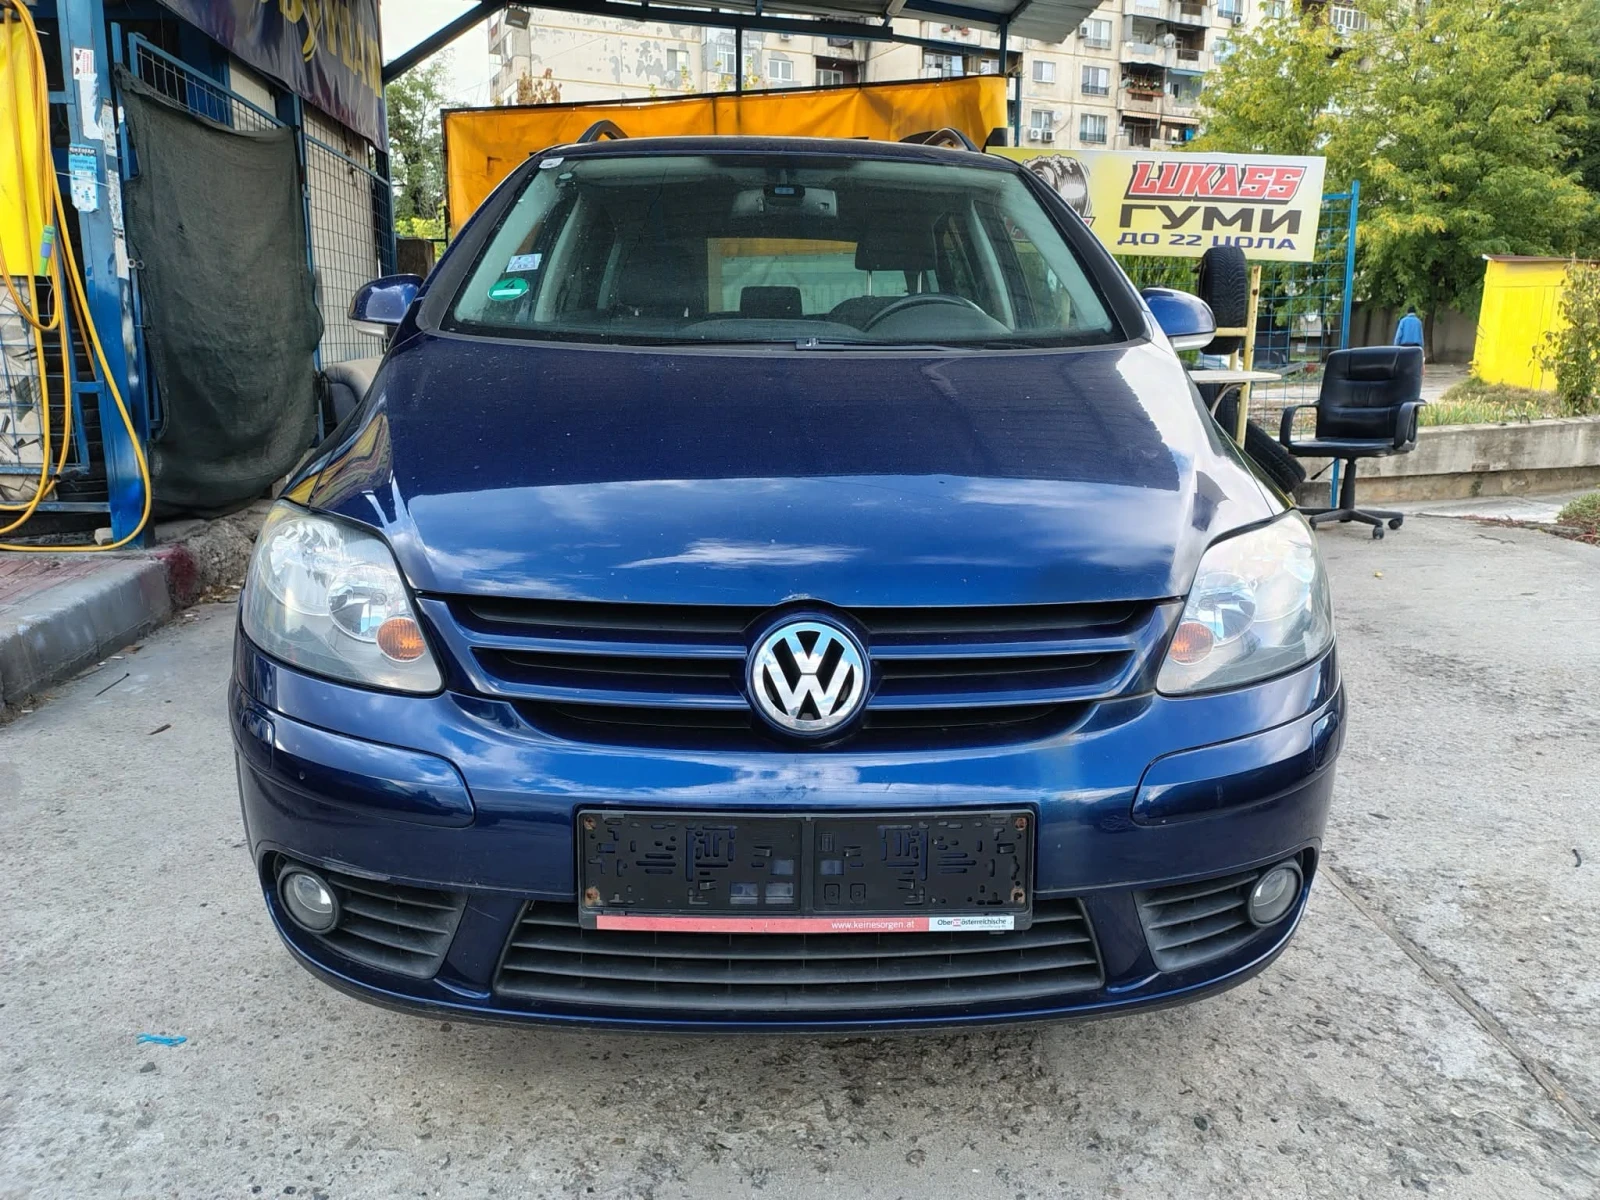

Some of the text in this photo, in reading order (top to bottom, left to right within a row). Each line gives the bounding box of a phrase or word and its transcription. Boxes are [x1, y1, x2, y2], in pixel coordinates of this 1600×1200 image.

[1126, 161, 1306, 203] LUKASS
[1119, 204, 1302, 235] ГУМИ
[1117, 232, 1297, 251] ДО 22 ЦОЛА
[757, 625, 860, 726] VW
[831, 919, 915, 930] www.keinesorgen.at
